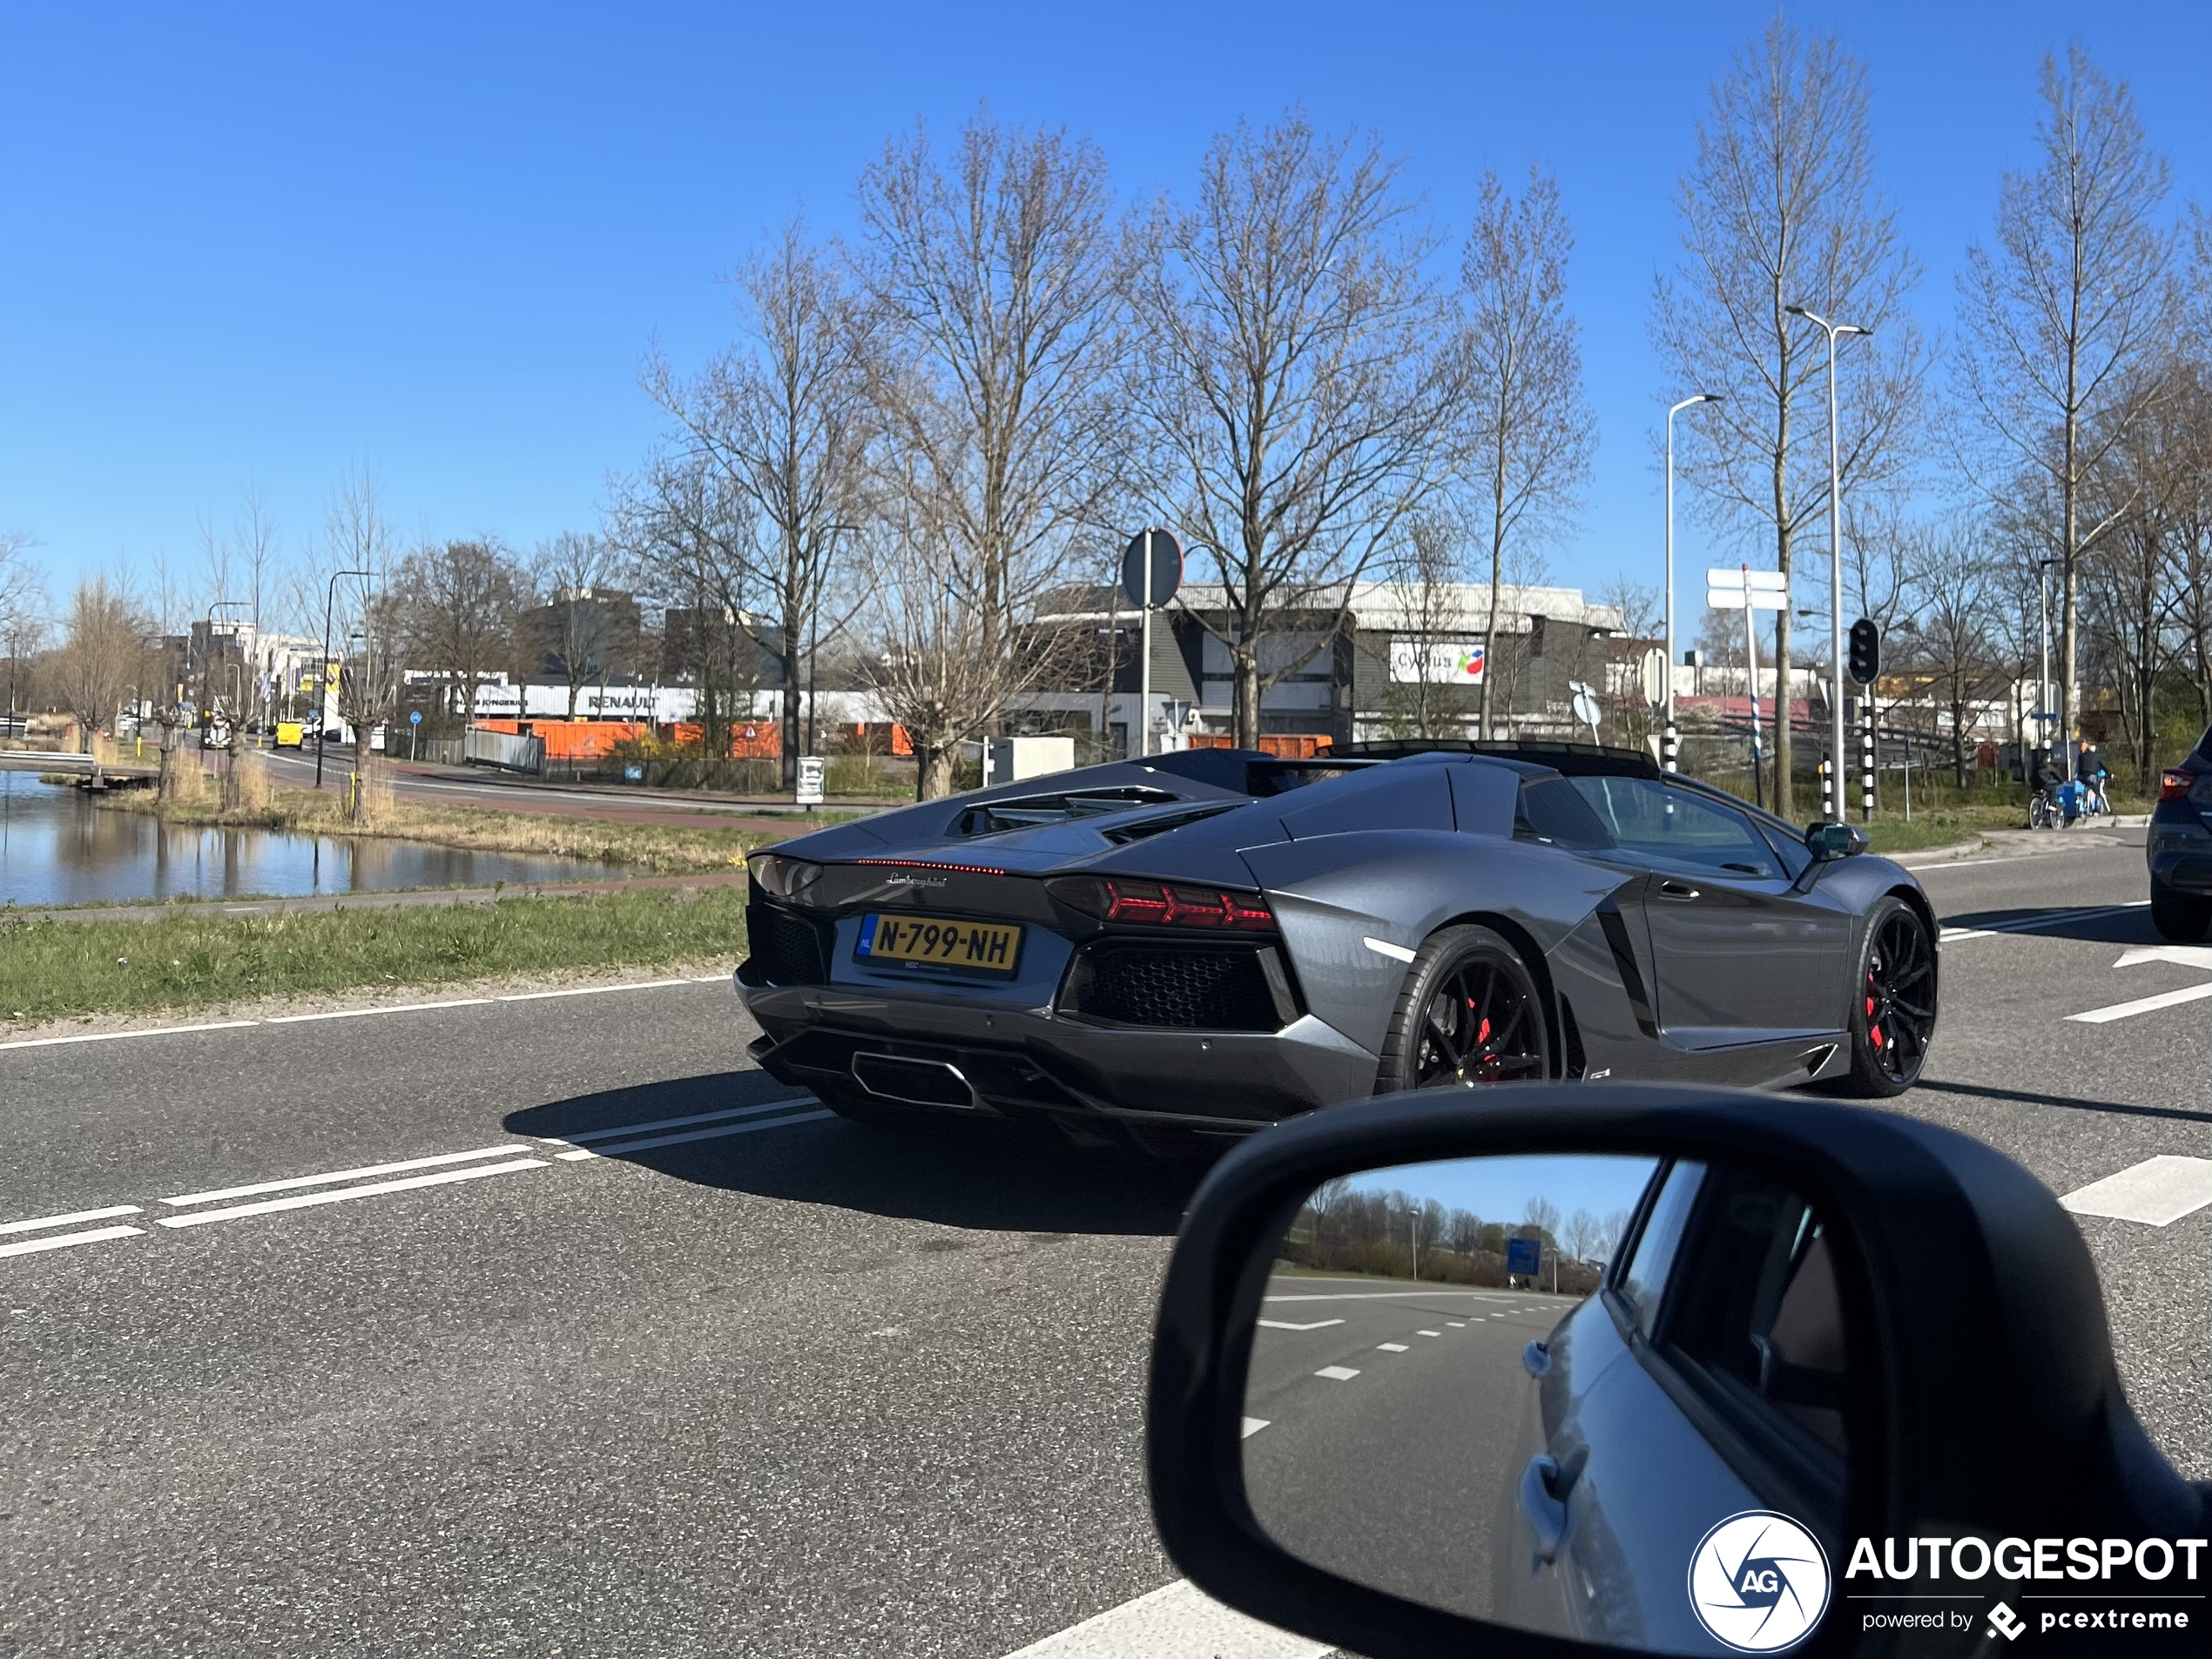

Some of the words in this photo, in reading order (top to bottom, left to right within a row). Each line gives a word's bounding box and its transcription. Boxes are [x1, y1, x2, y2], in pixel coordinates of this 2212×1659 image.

[589, 696, 659, 708] RENAULT
[886, 872, 948, 887] Lamborghini
[860, 939, 871, 948] NL
[879, 921, 1010, 964] N-799-NH
